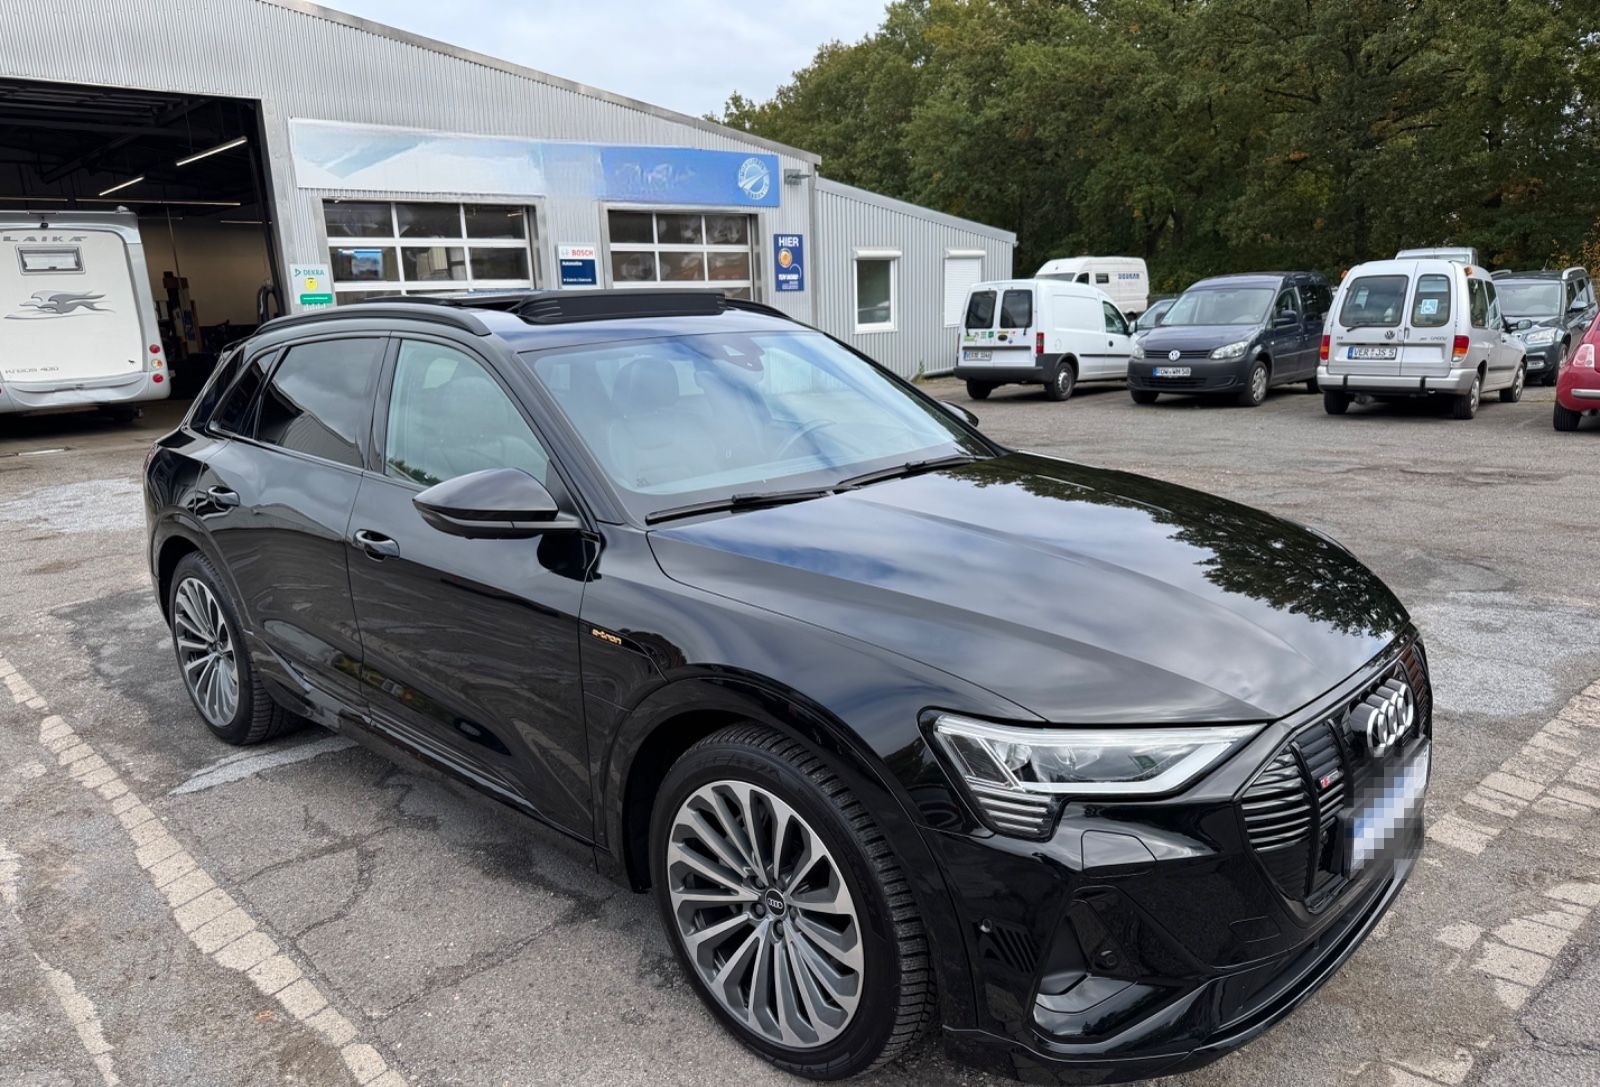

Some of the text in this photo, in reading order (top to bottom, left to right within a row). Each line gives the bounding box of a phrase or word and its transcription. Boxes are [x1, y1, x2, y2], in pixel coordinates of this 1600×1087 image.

[778, 236, 800, 247] HIER
[1355, 347, 1369, 356] VER
[1375, 348, 1386, 356] JS
[592, 628, 622, 645] e-tron
